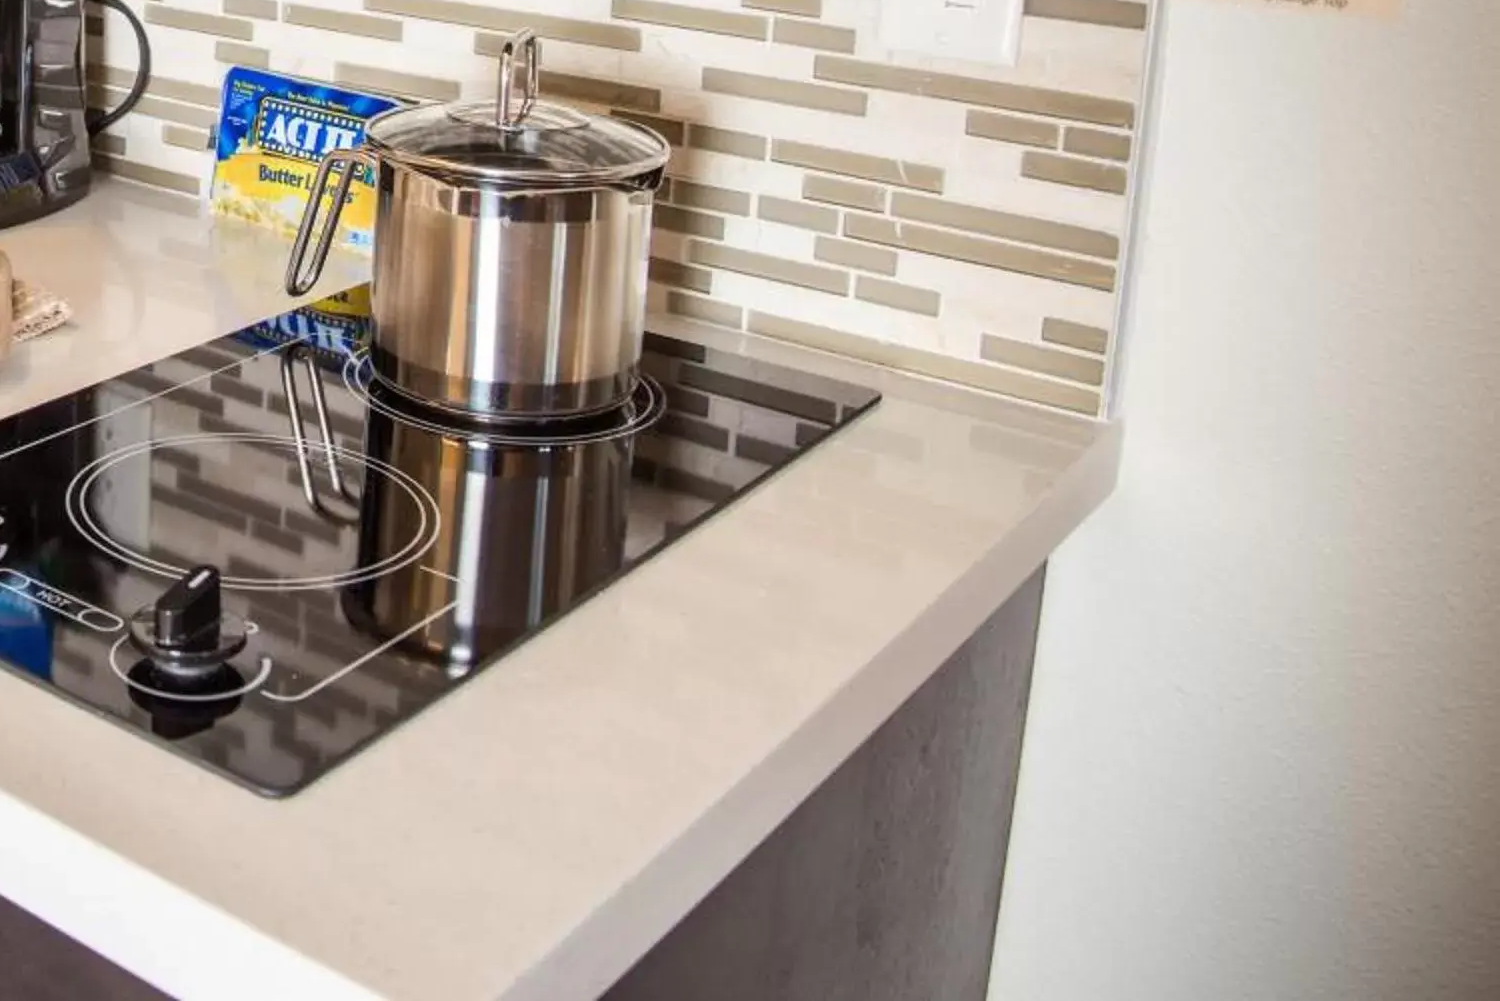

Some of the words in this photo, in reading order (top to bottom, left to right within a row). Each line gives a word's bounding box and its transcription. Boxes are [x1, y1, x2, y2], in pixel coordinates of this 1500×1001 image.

[266, 113, 323, 150] ACT
[258, 164, 305, 188] Butter
[36, 590, 73, 608] HOT
